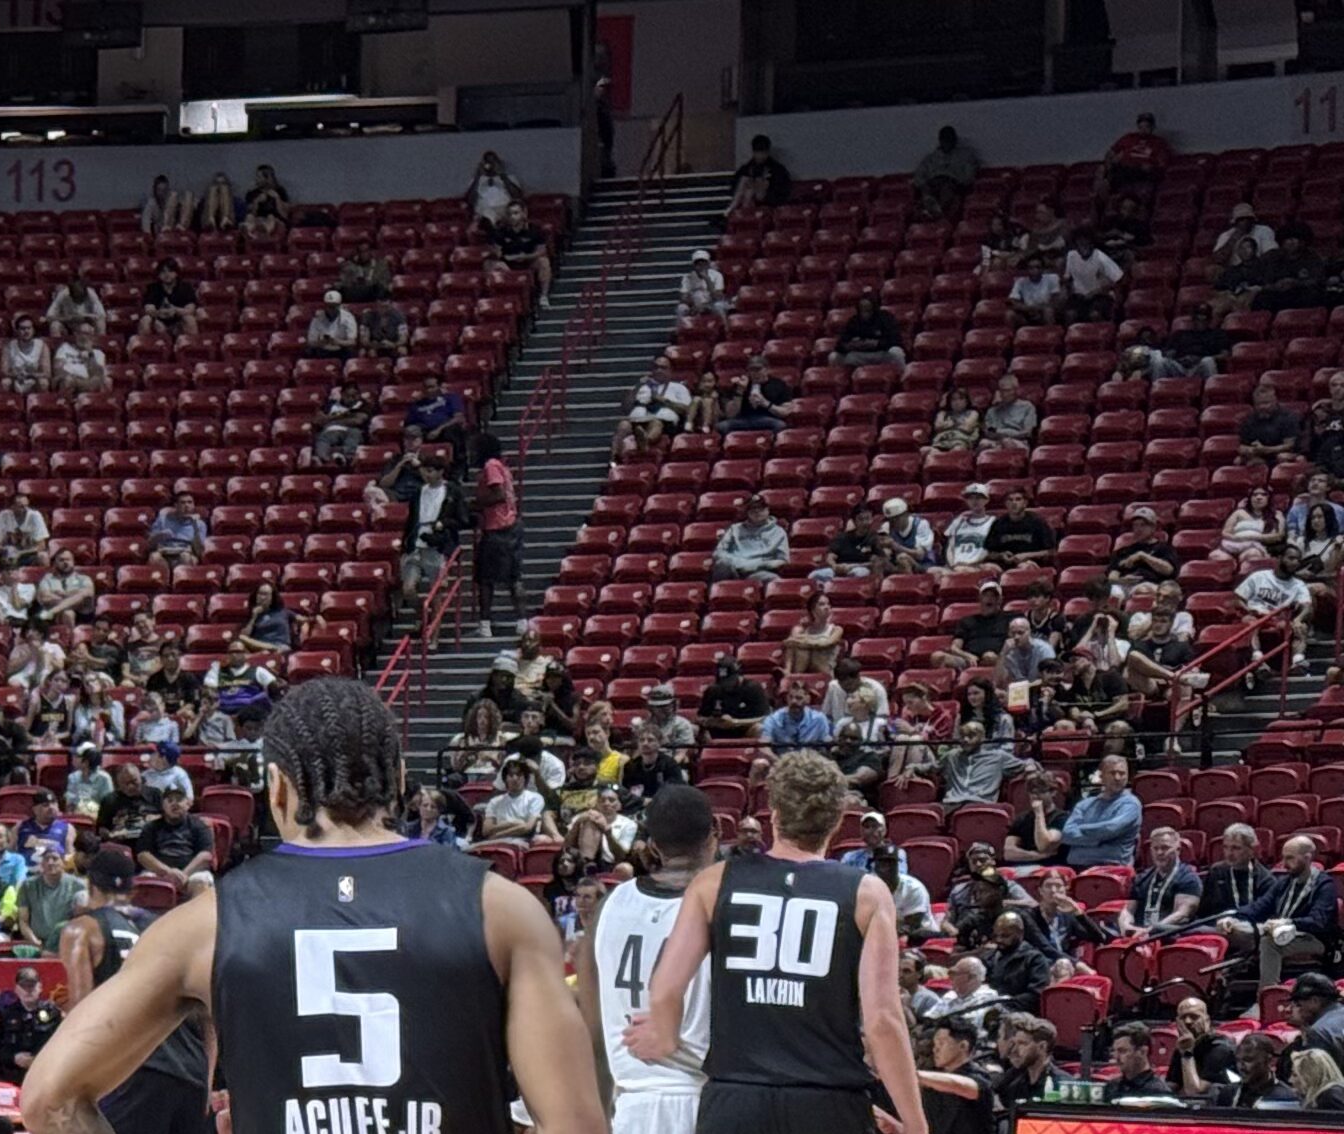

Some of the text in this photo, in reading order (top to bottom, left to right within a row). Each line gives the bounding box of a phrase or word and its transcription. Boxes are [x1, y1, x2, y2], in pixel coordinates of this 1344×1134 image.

[7, 159, 76, 202] 113
[725, 892, 839, 977] 30
[294, 927, 402, 1088] 5
[746, 977, 805, 1007] LAKHIN
